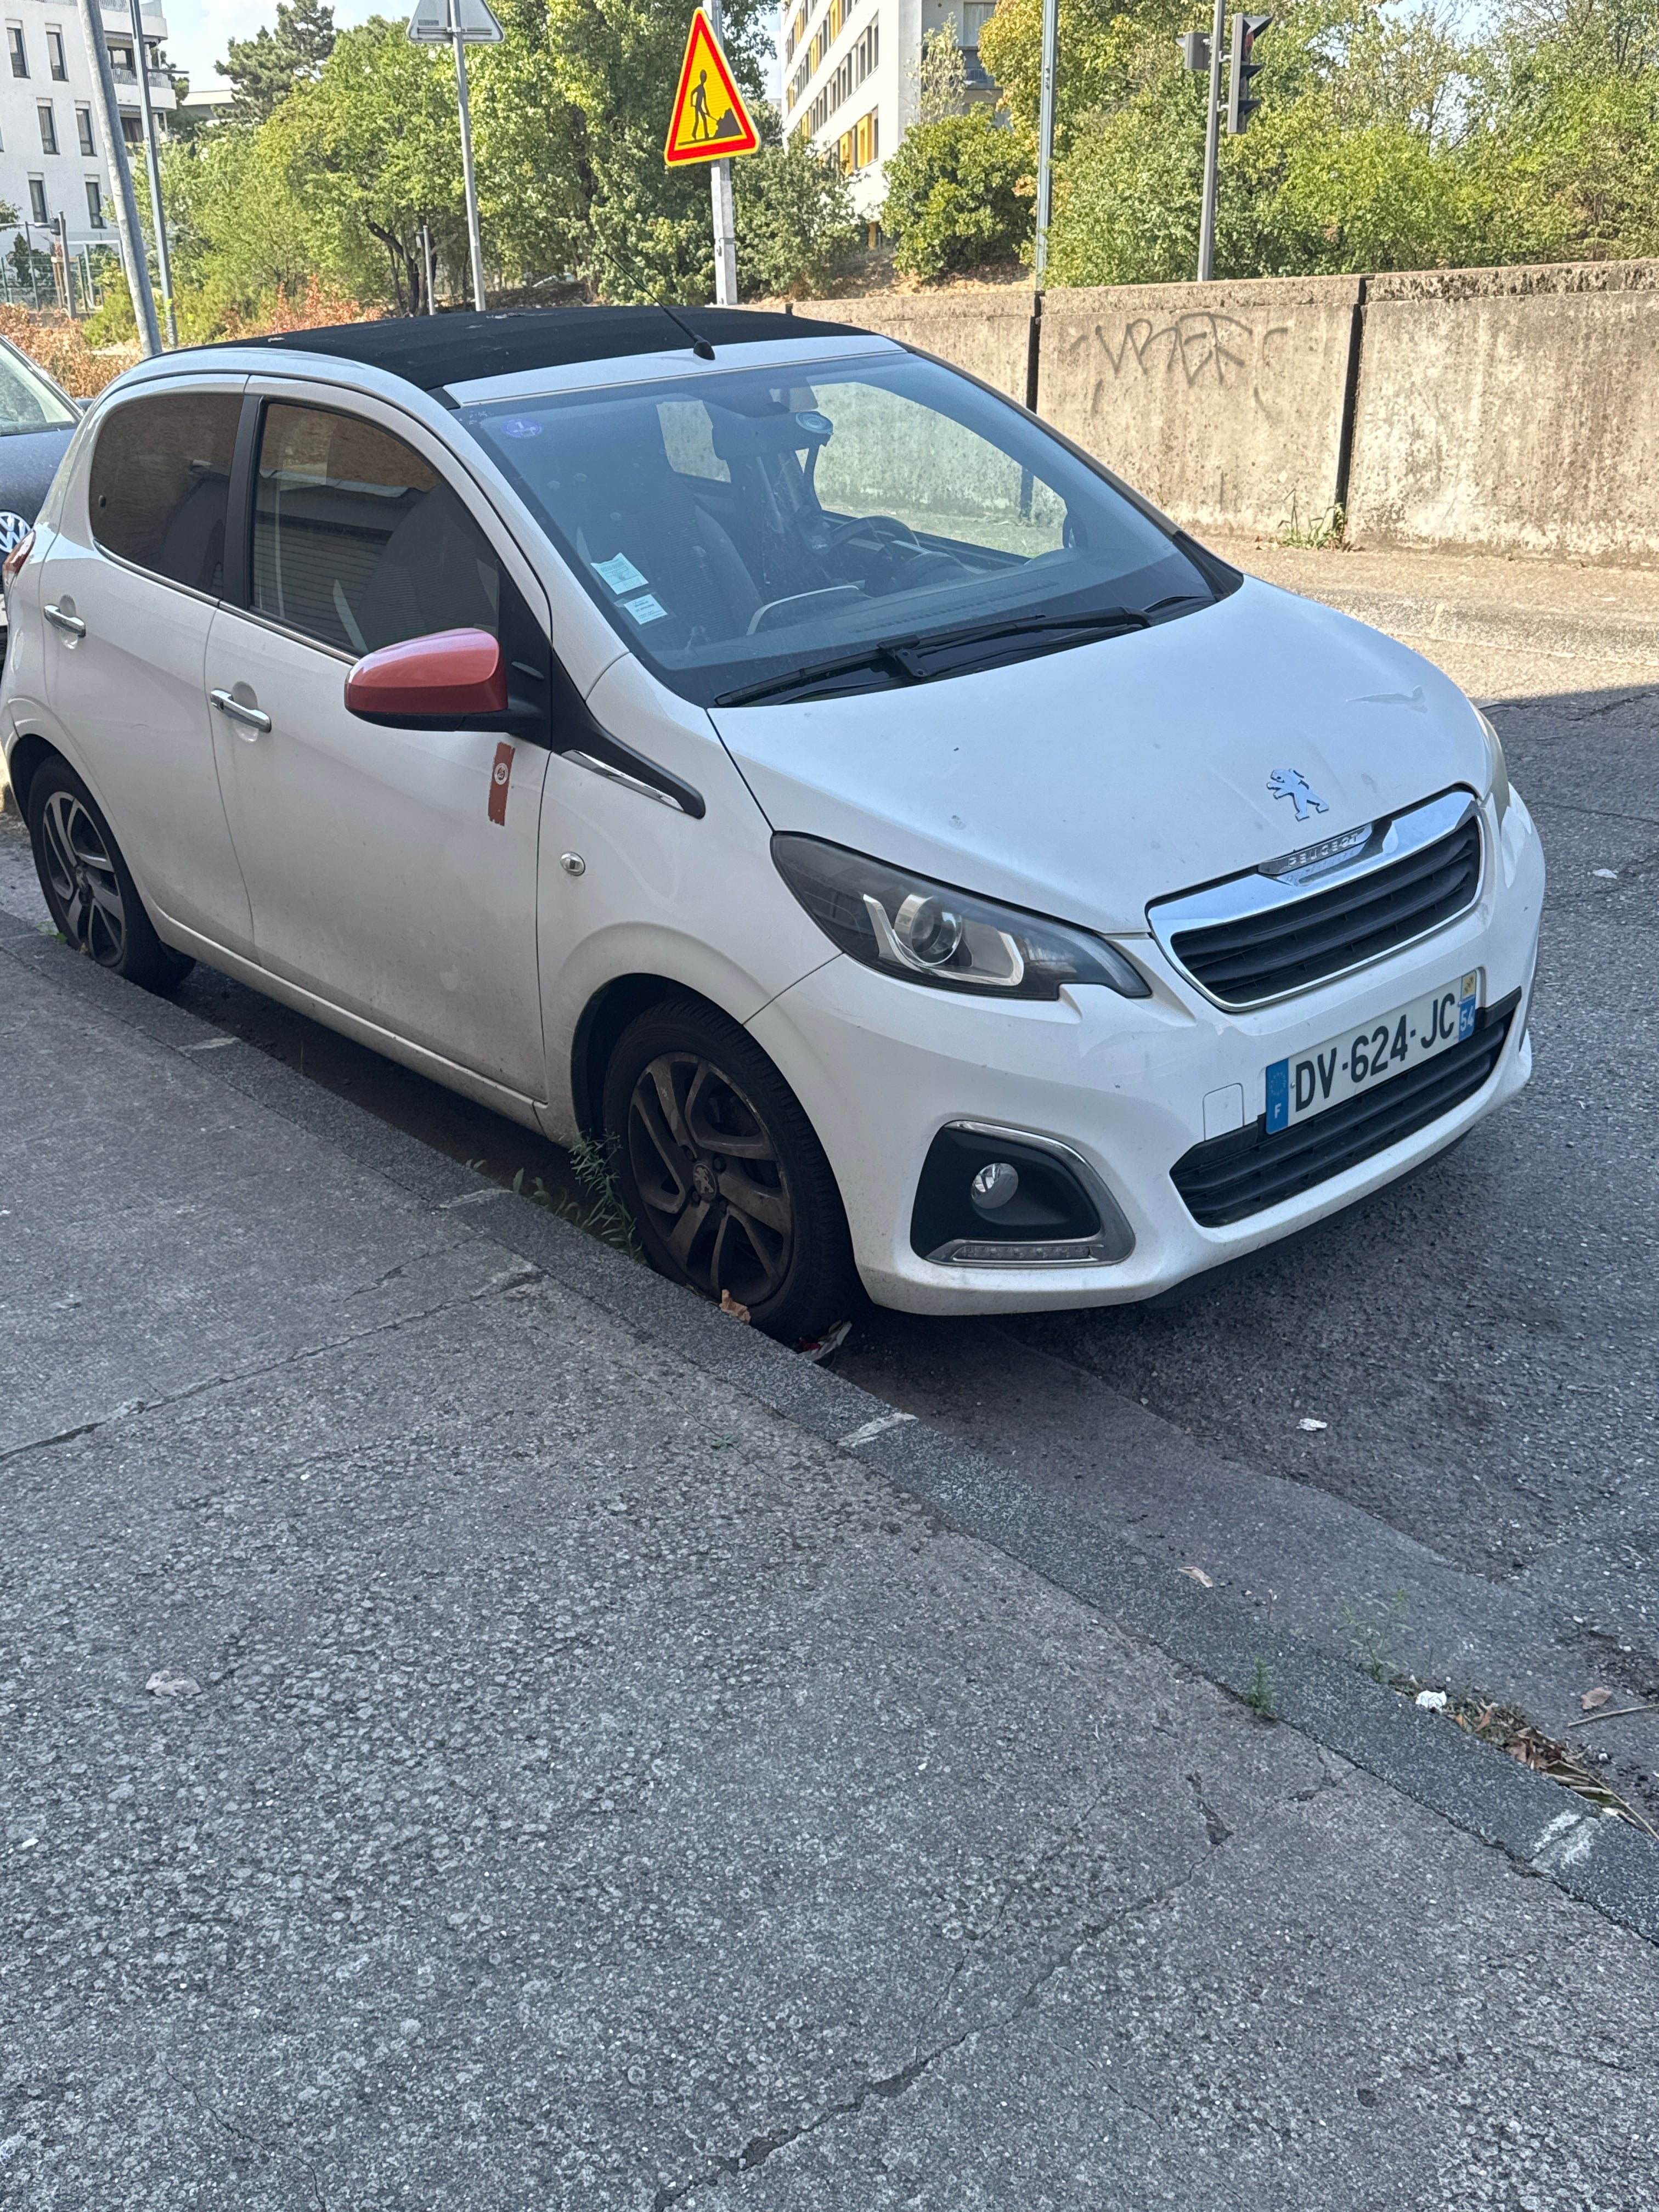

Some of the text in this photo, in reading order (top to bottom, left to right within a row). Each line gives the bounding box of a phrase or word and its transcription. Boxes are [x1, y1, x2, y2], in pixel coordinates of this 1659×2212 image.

[1288, 833, 1358, 868] PEUGEOT
[1274, 1102, 1282, 1119] F
[1460, 1005, 1475, 1032] 54
